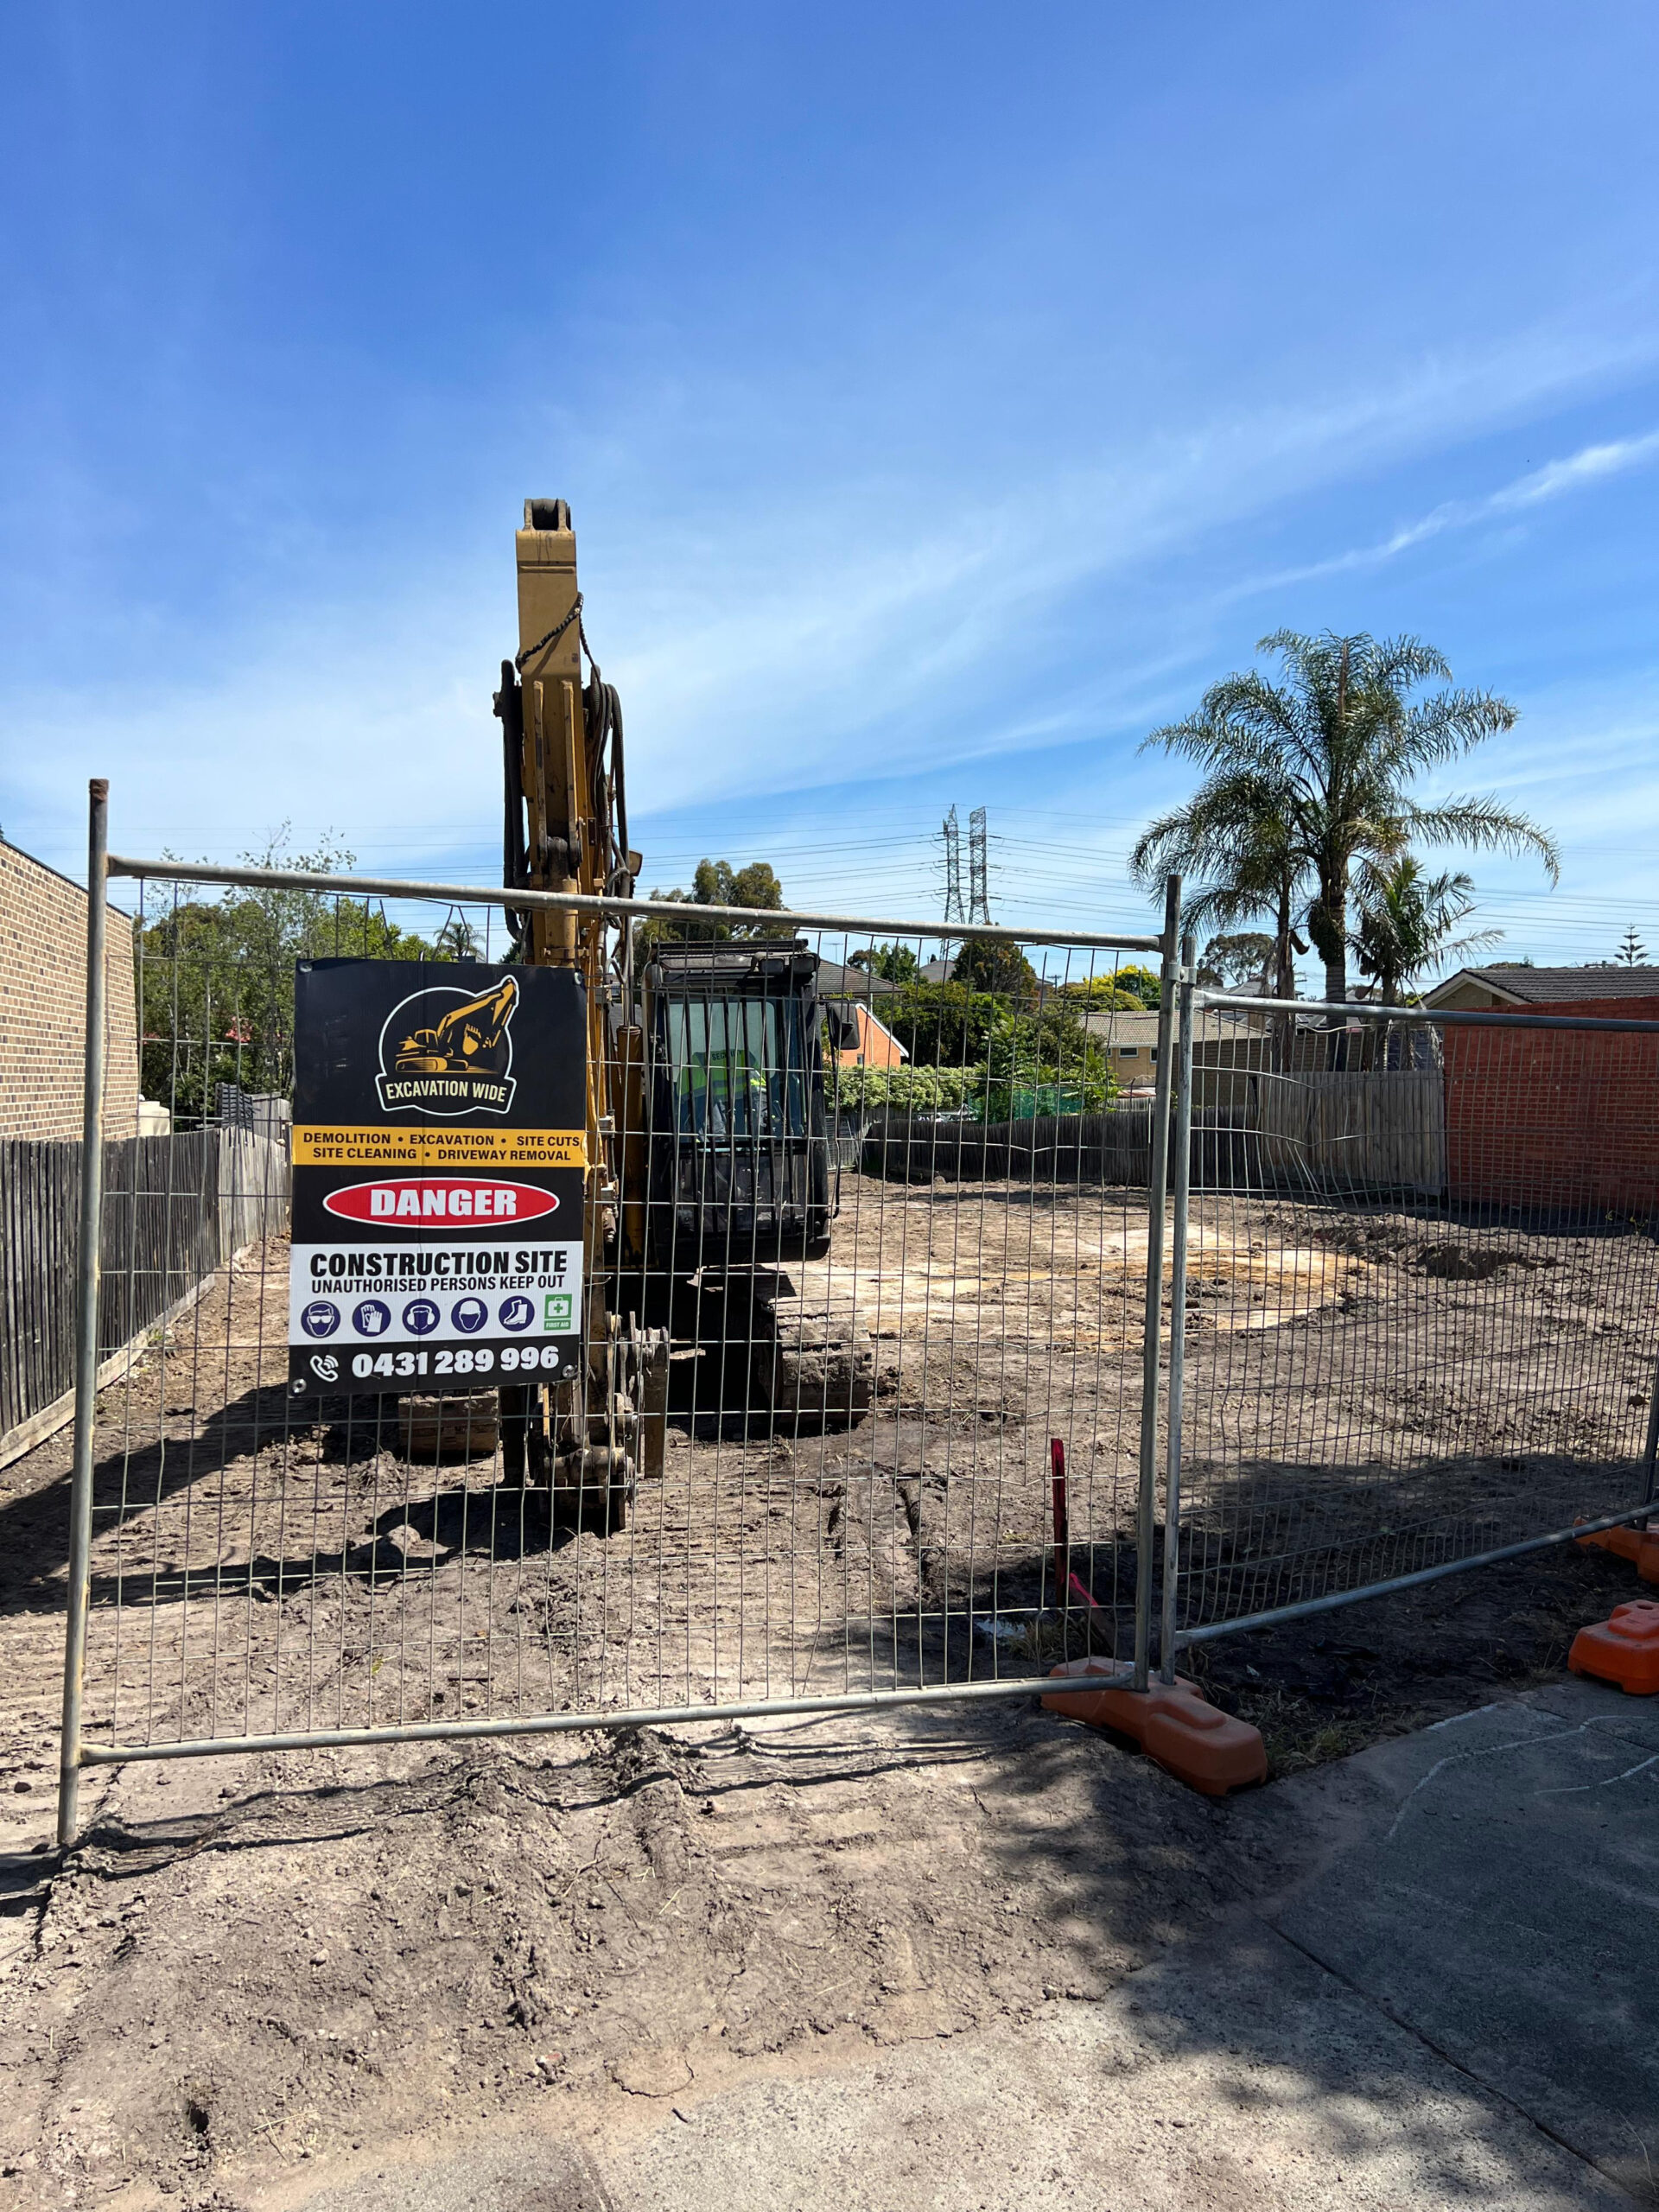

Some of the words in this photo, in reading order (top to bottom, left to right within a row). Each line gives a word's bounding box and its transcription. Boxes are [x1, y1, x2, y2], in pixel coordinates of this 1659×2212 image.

[385, 1080, 468, 1100] EXCAVATION
[472, 1082, 508, 1103] WIDE
[303, 1132, 391, 1144] DEMOLITION
[410, 1134, 494, 1146] EXCAVATION
[517, 1135, 545, 1147] SITE
[547, 1136, 581, 1147] CUTS
[313, 1147, 344, 1159] SITE
[346, 1148, 417, 1160] CLEANING
[438, 1149, 507, 1160] DRIVEWAY
[510, 1150, 571, 1161] REMOVAL
[370, 1189, 517, 1217] DANGER
[310, 1251, 510, 1277] CONSTRUCTION
[515, 1250, 568, 1274] SITE
[311, 1278, 427, 1294] UNAUTHORISED
[430, 1276, 496, 1291] PERSONS
[499, 1275, 535, 1289] KEEP
[537, 1274, 565, 1288] OUT
[352, 1351, 428, 1378] 0431
[434, 1348, 494, 1375] 289
[500, 1345, 559, 1371] 996
